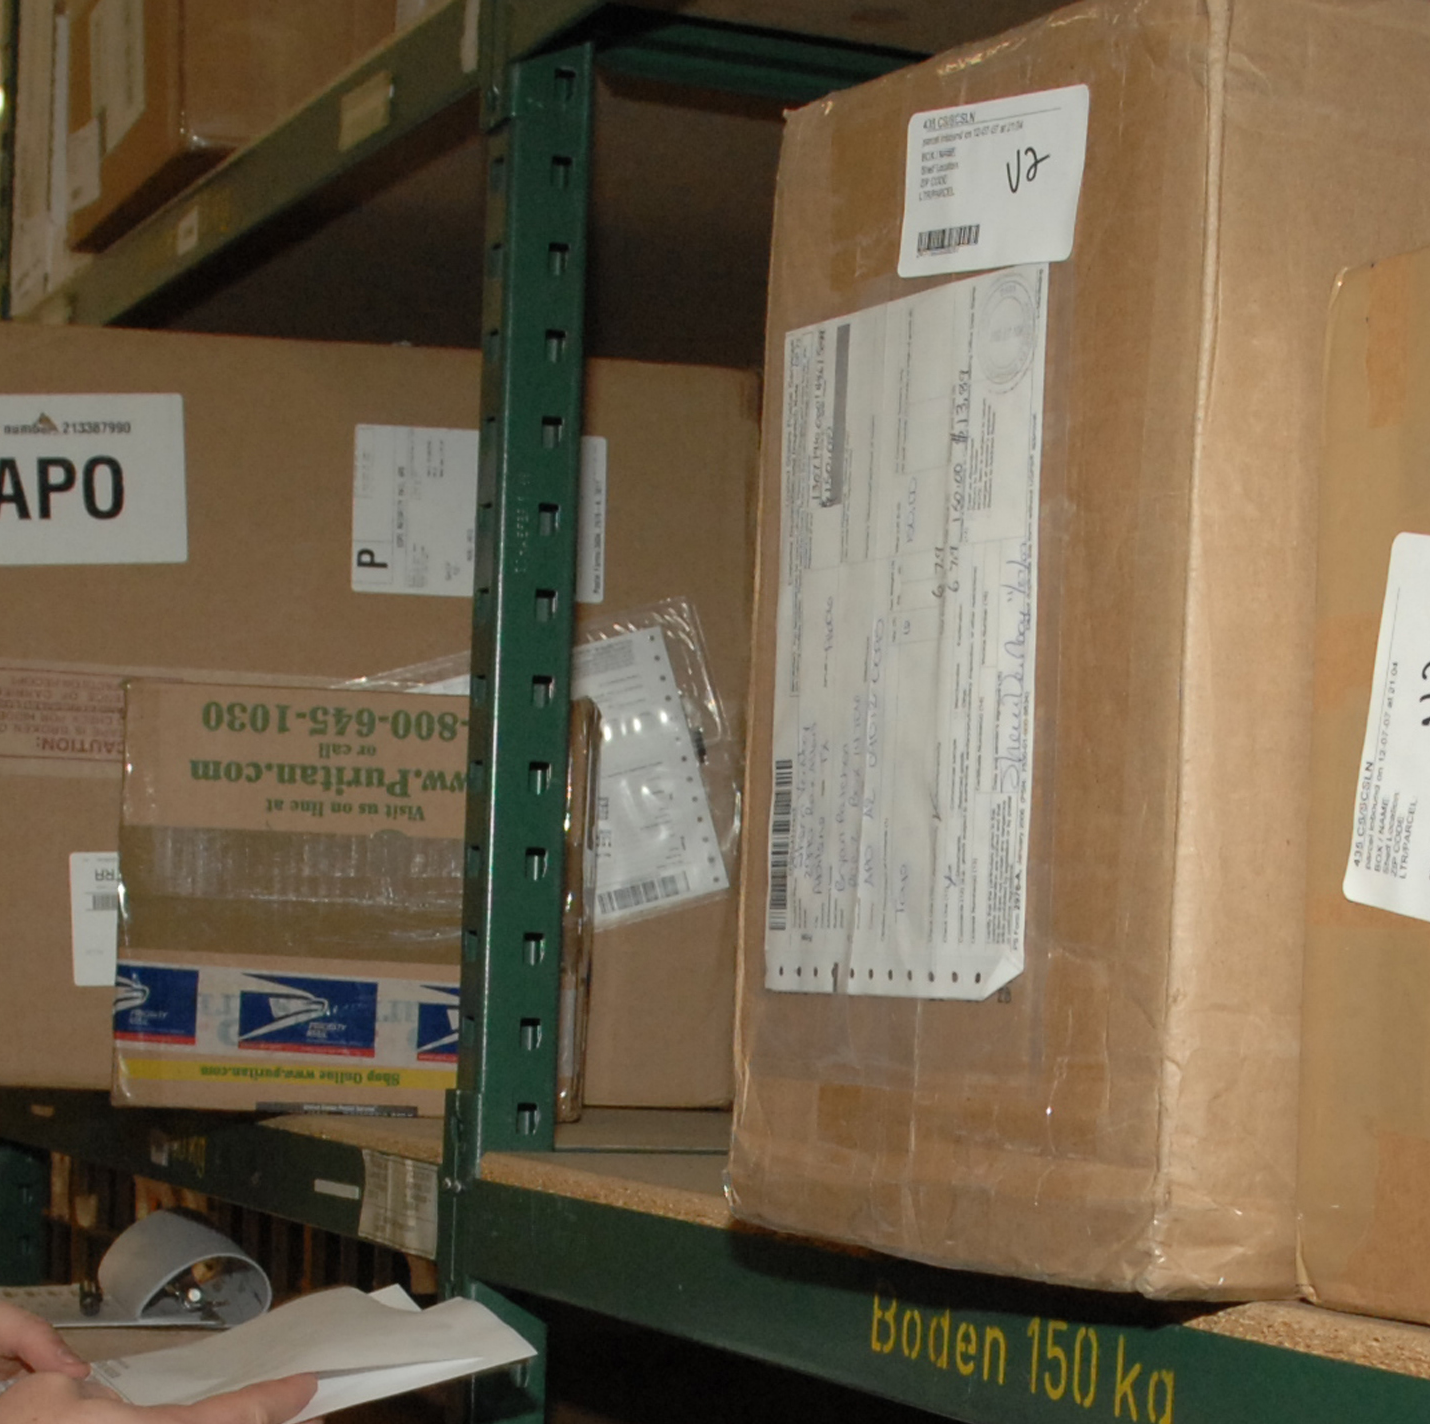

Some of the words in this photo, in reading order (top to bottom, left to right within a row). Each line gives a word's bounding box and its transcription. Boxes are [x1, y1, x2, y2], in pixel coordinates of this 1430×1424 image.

[357, 548, 388, 569] P
[319, 743, 351, 759] call
[360, 744, 376, 756] or
[267, 799, 283, 812] at
[291, 800, 323, 816] line
[331, 802, 351, 814] on
[359, 802, 379, 814] us
[386, 805, 425, 820] Visit
[1354, 840, 1363, 867] 435
[871, 1294, 1007, 1385] Boden
[1027, 1316, 1098, 1408] 150
